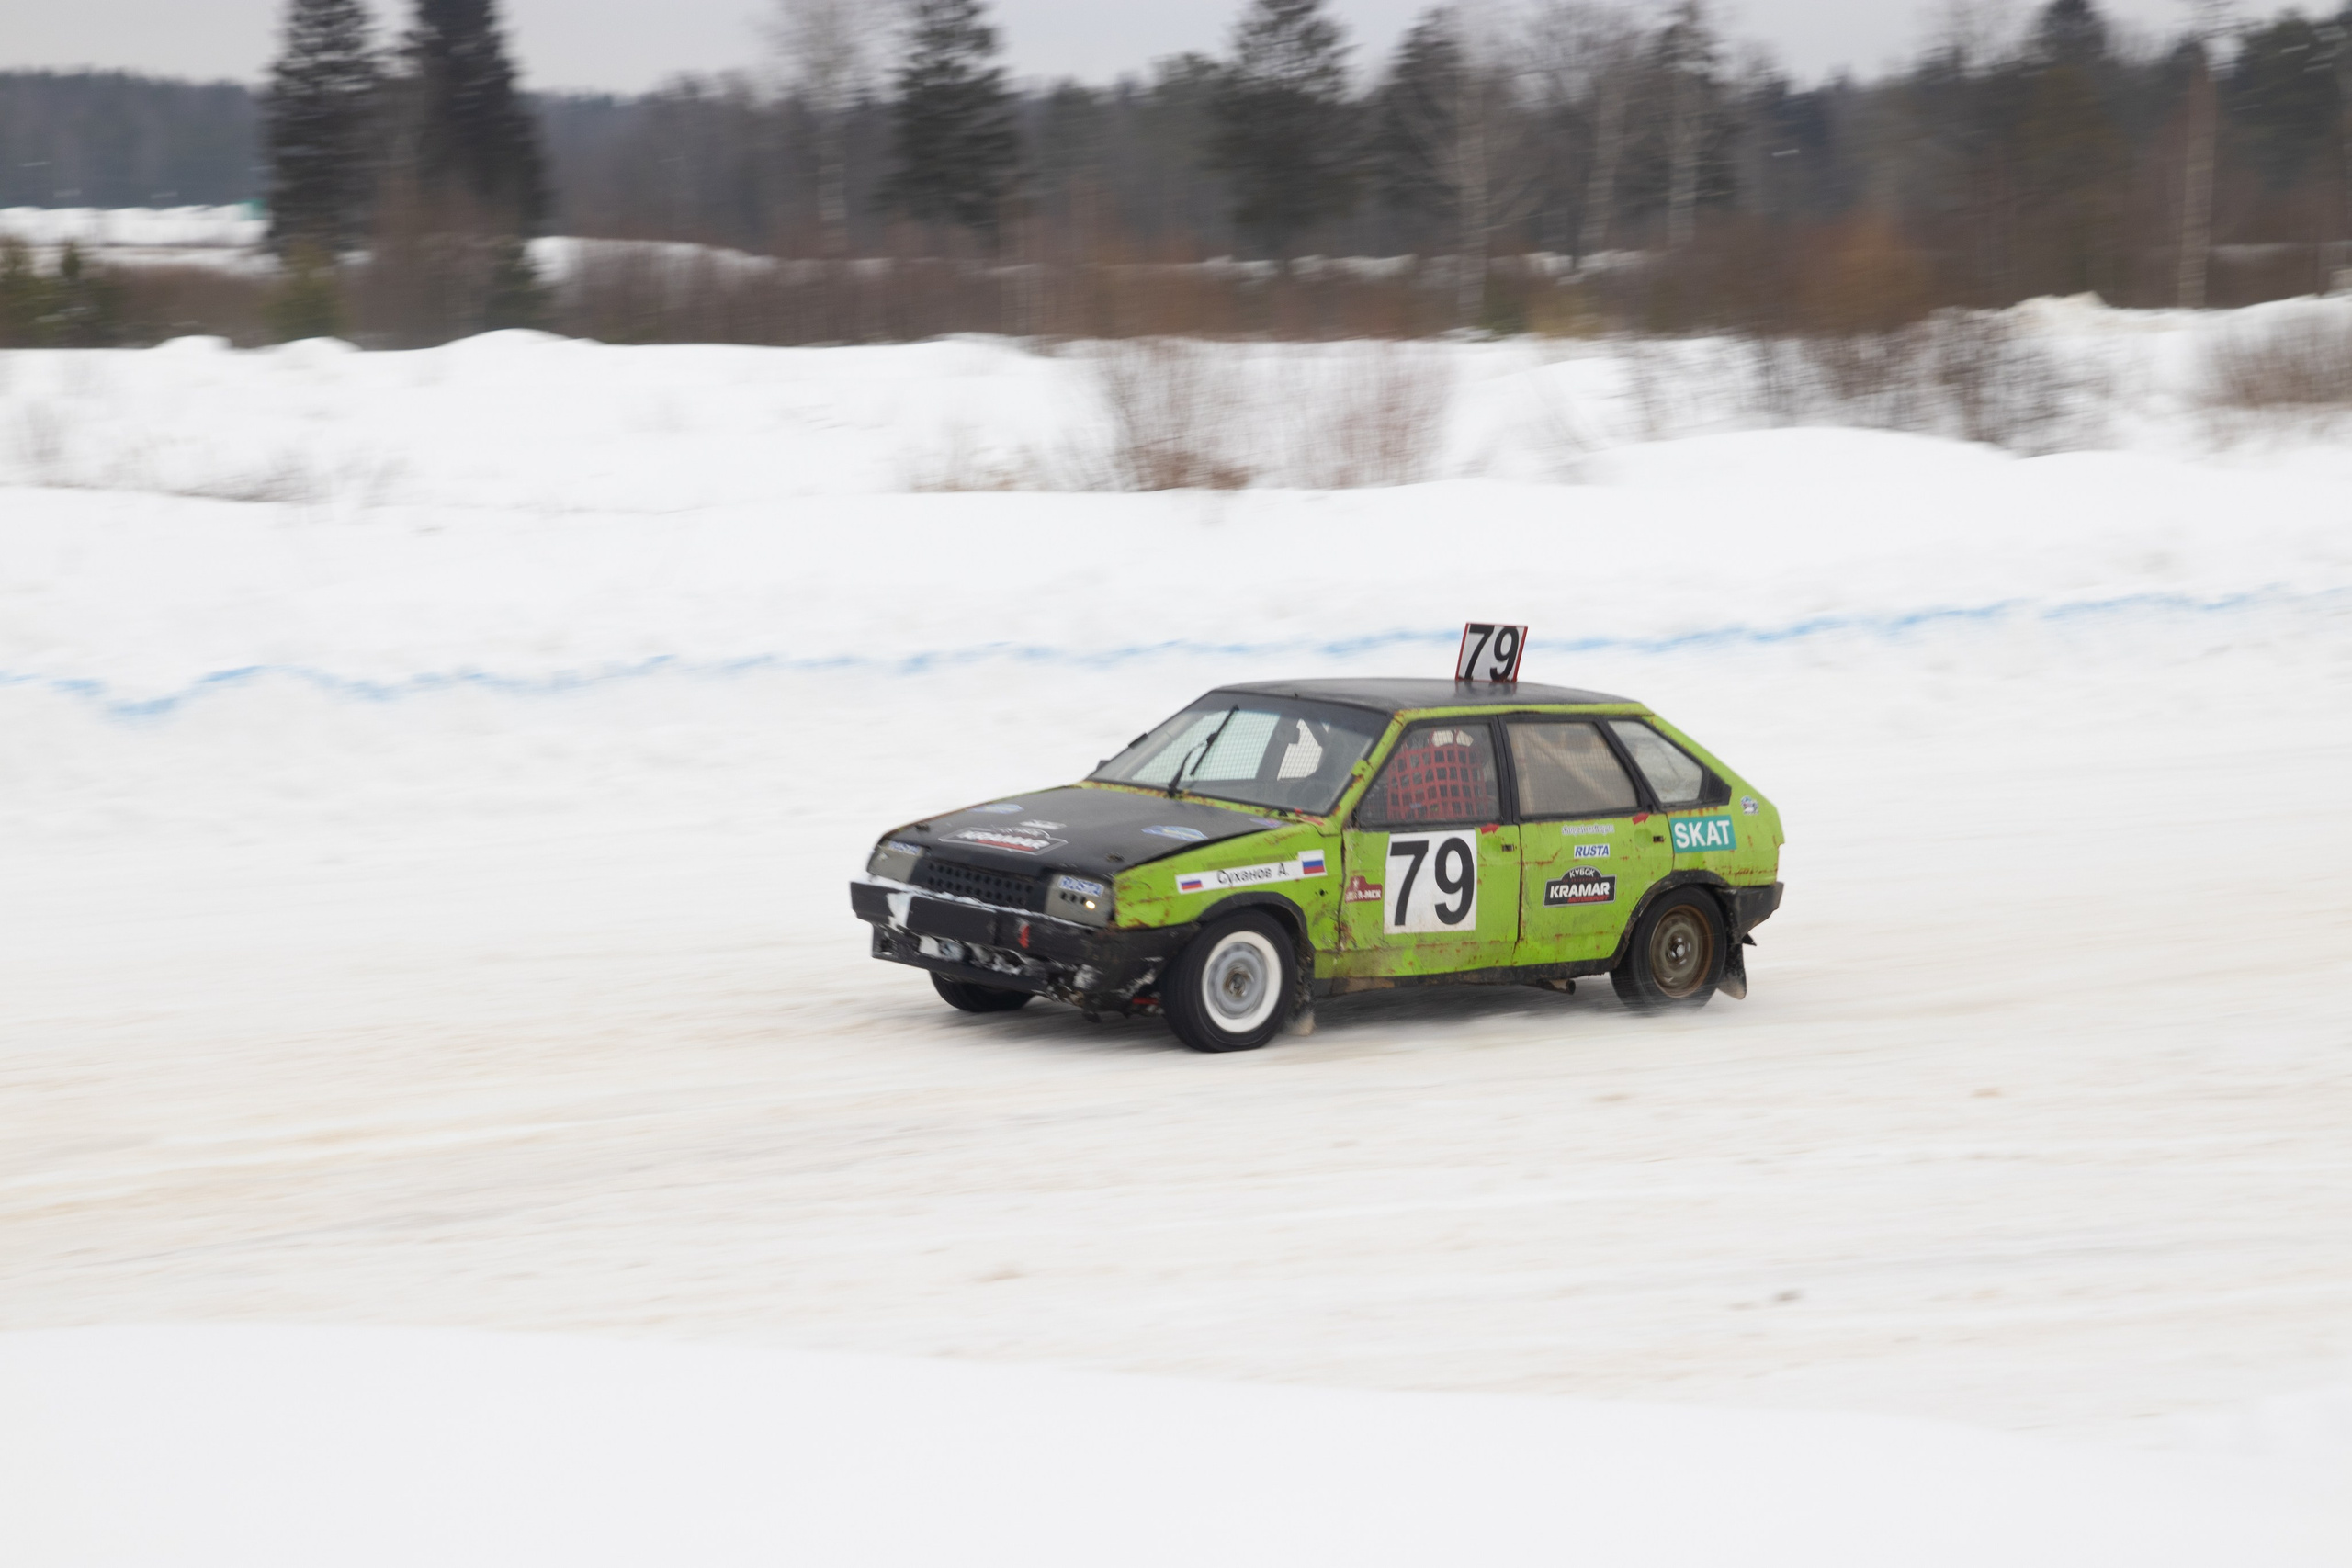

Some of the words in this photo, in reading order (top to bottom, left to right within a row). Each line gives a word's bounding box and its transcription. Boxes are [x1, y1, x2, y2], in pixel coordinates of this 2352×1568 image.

[1464, 623, 1520, 682] 79
[1674, 819, 1731, 849] SKAT
[1574, 844, 1610, 858] RUSTA
[1216, 868, 1272, 889] Суханов
[1389, 837, 1475, 926] 79
[1549, 882, 1611, 899] KRAMAR
